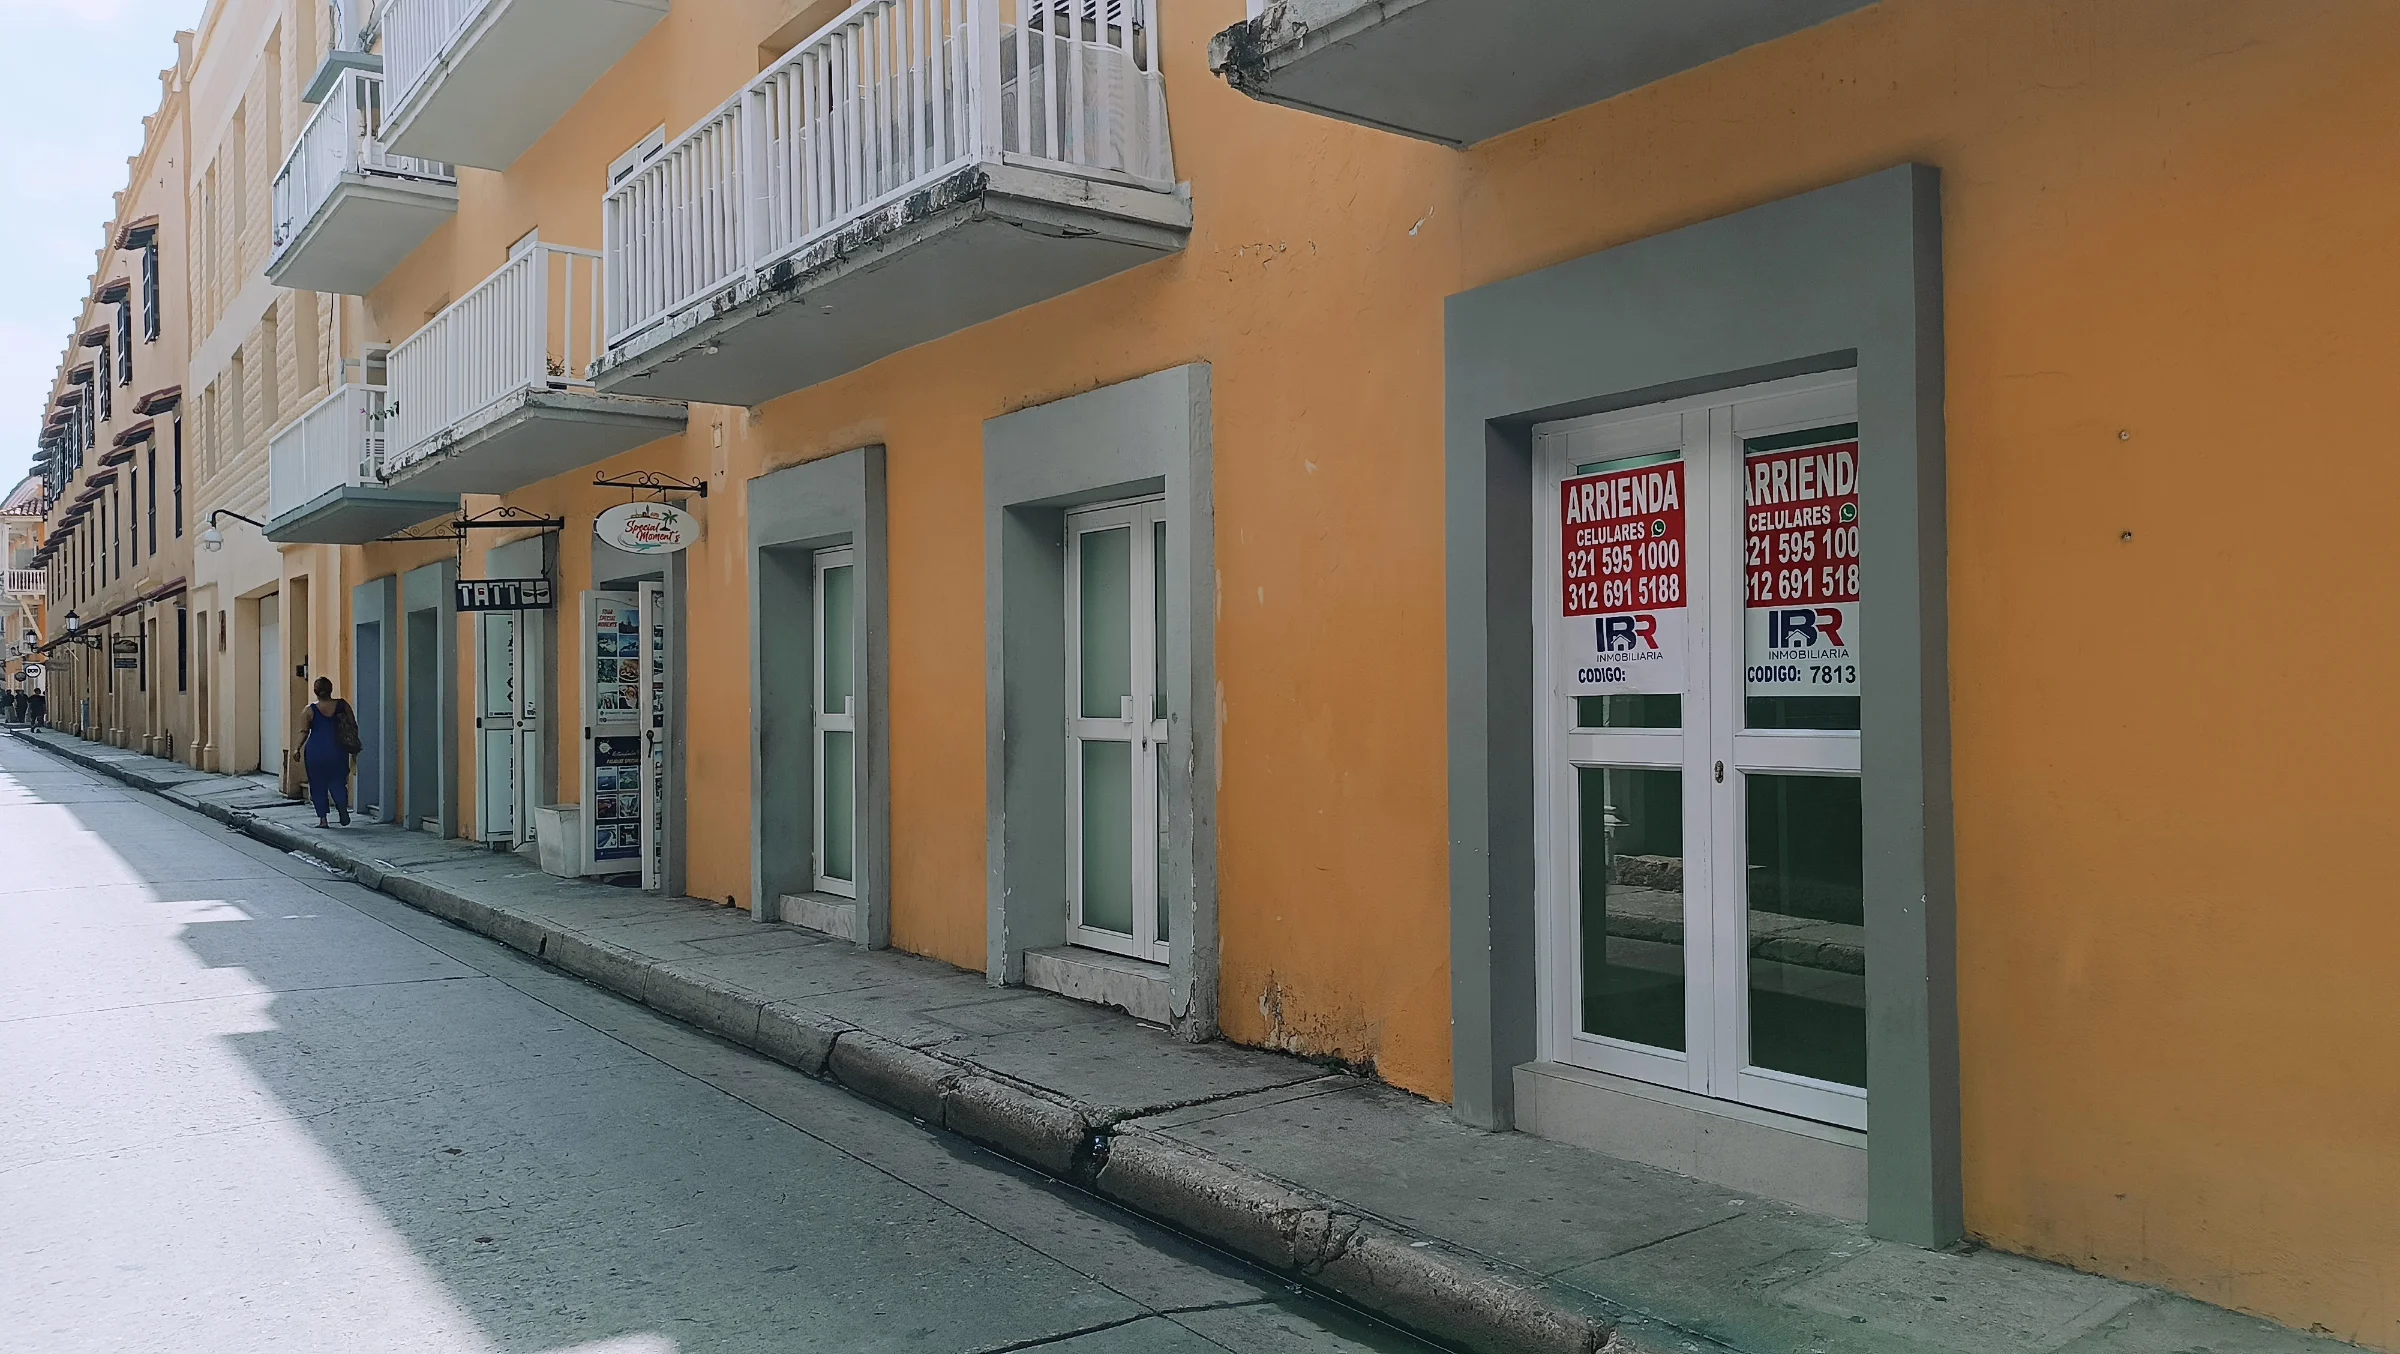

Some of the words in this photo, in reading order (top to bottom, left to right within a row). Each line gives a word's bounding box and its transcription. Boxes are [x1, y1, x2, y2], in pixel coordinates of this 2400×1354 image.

[1745, 451, 1858, 506] RRIEND
[1566, 470, 1679, 524] ARRIENDA
[624, 520, 661, 534] Special
[1576, 521, 1645, 546] CELULARES
[1749, 505, 1831, 532] CELULARES
[1567, 548, 1595, 578] 321
[1602, 545, 1633, 575] 595
[1638, 539, 1680, 570] 1000
[1745, 535, 1770, 566] 21
[1778, 531, 1815, 563] 595
[1568, 582, 1598, 611] 312
[1603, 578, 1632, 607] 691
[1639, 573, 1680, 605] 5188
[1778, 567, 1813, 599] 691
[1595, 614, 1659, 652] IBR
[1768, 608, 1845, 648] IBR
[1596, 651, 1664, 662] INMOBILIARIA
[1768, 648, 1850, 660] INMOBILIARIA
[1578, 667, 1626, 683] CODIGO:
[1747, 665, 1801, 683] CODIGO:
[1809, 665, 1856, 684] 7813
